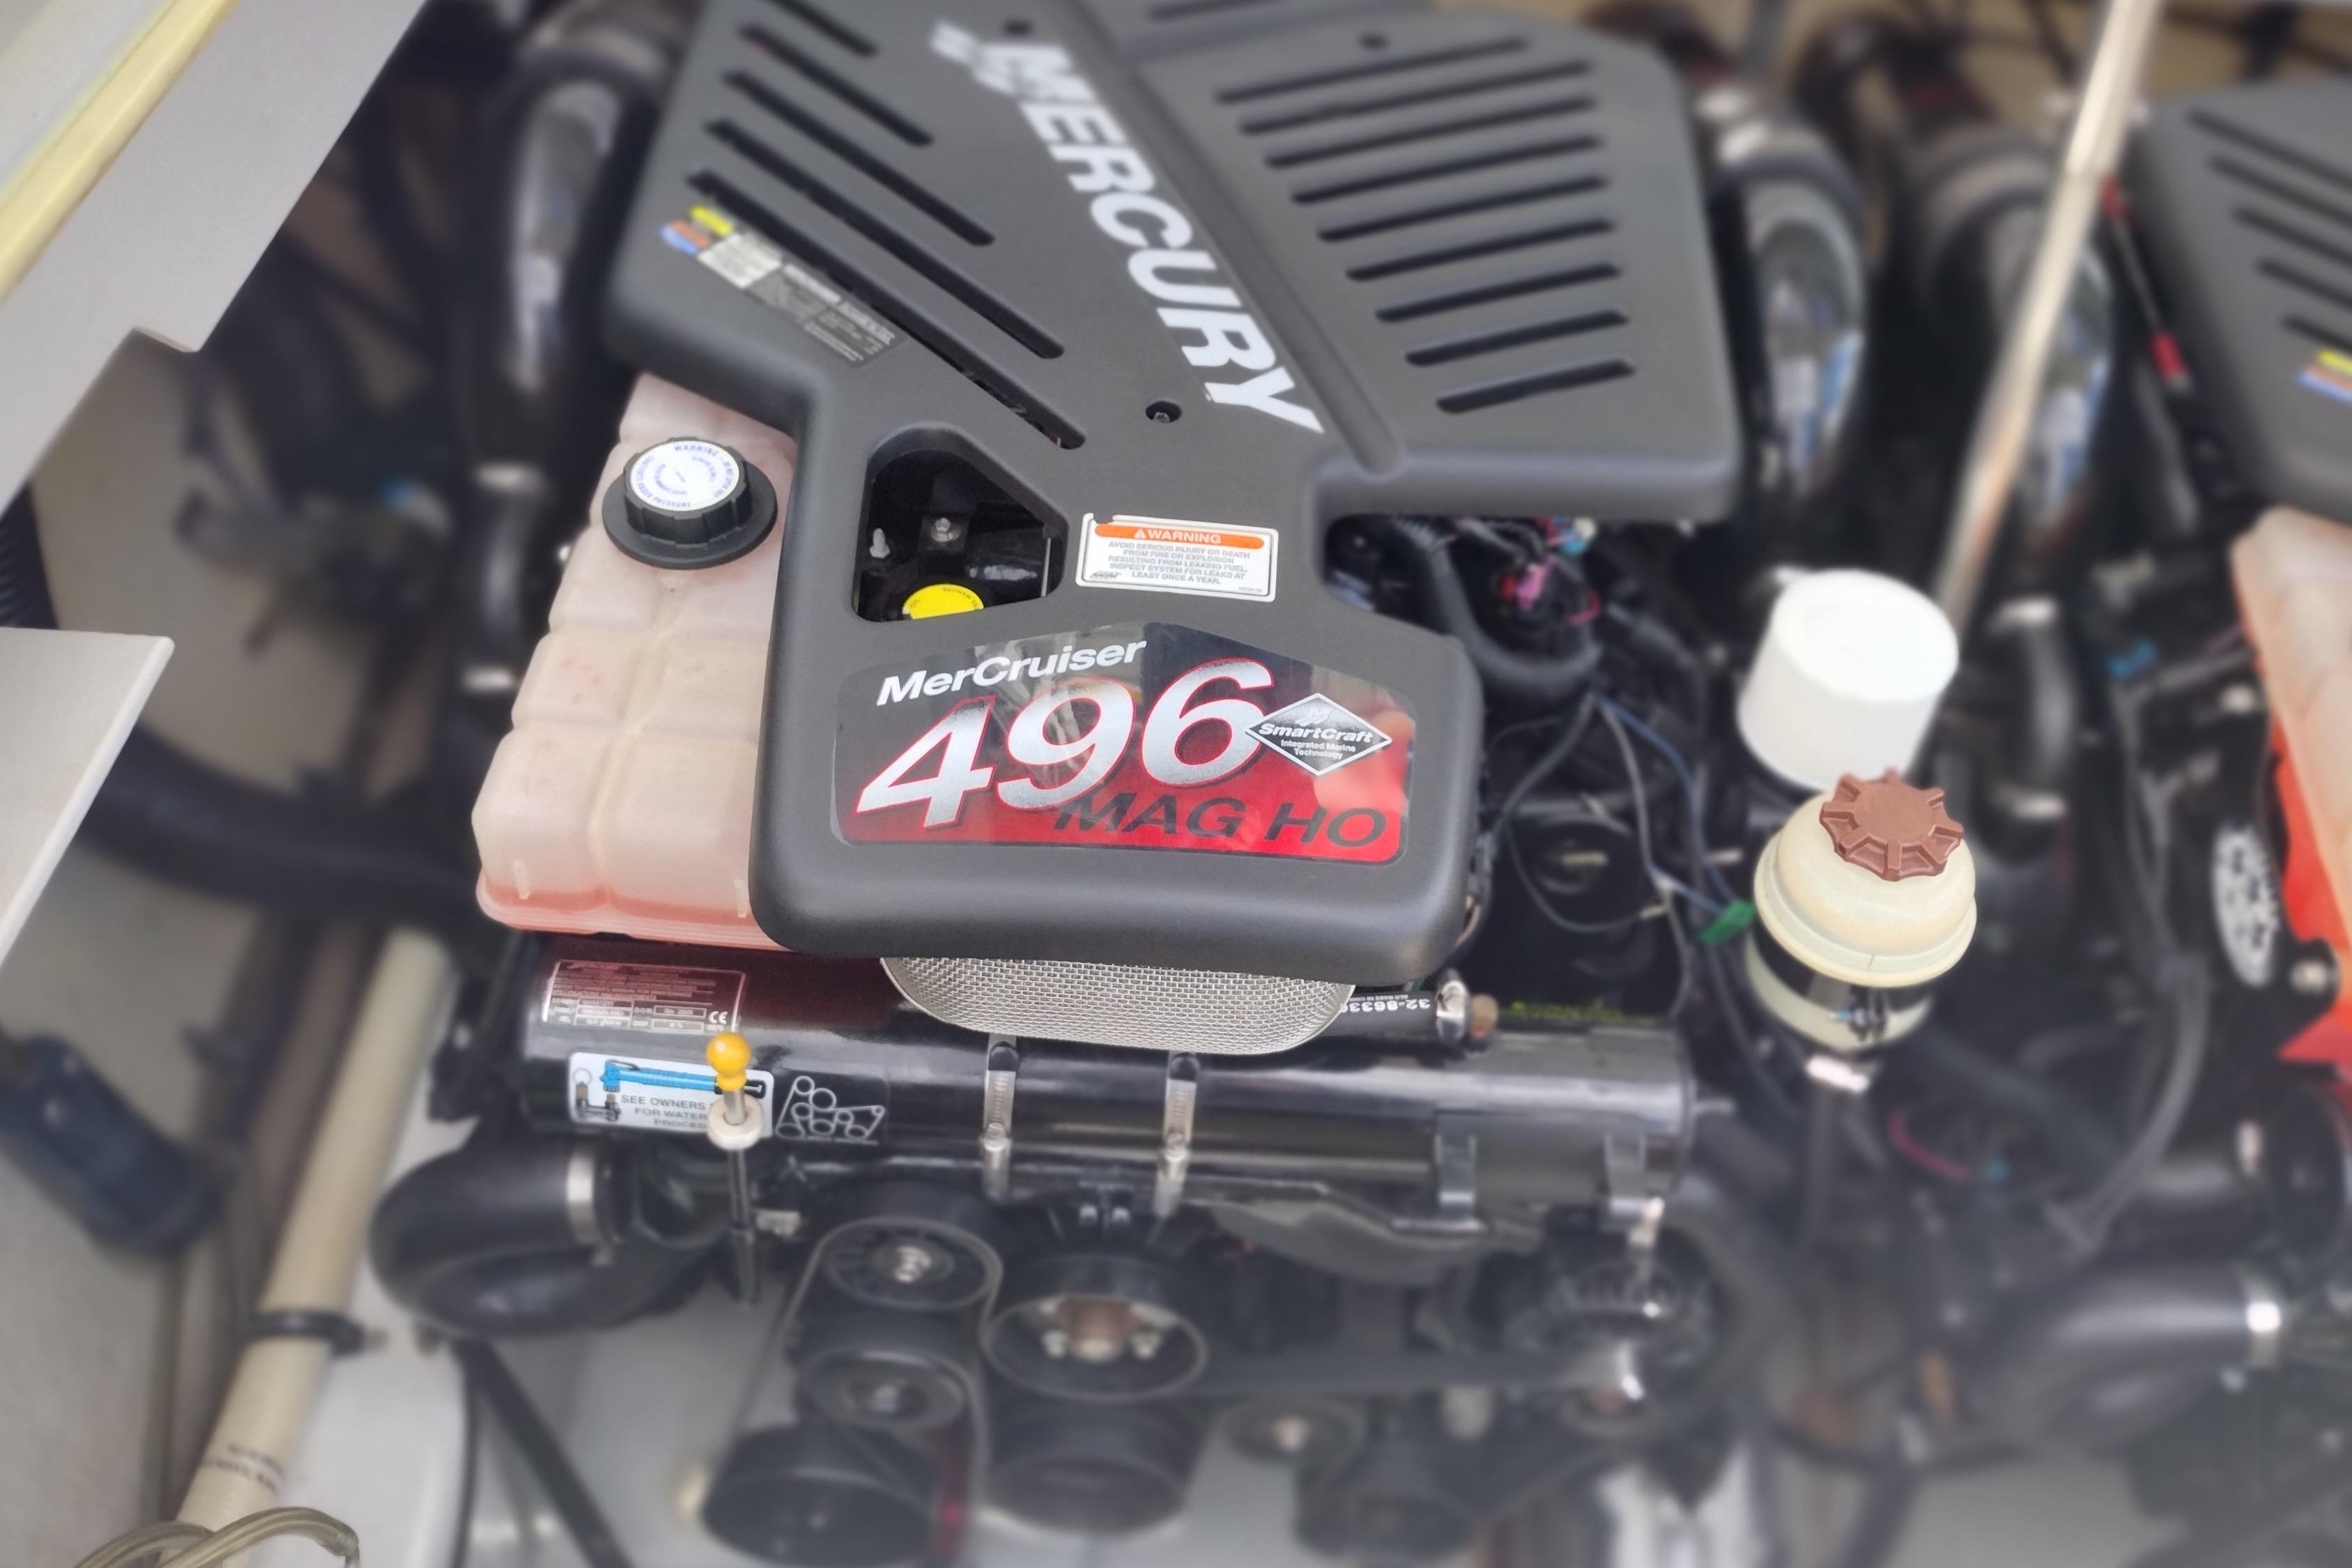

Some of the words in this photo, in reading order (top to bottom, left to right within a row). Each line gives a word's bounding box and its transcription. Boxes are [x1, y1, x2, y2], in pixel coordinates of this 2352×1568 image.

[973, 43, 1324, 433] MERCURY
[674, 444, 720, 457] WARNING
[1147, 529, 1222, 544] WARNING
[1108, 541, 1135, 549] AVOID
[1137, 544, 1174, 552] SERIOUS
[1176, 546, 1206, 555] INJURY
[1222, 550, 1250, 559] DEATH
[1108, 555, 1156, 564] RESULTING
[1185, 561, 1222, 570] LEAKING
[1186, 553, 1234, 564] EXPLOSION
[1109, 562, 1146, 571] INSPECT
[1148, 565, 1183, 574] SYSTEM
[1204, 569, 1233, 579] LEAKS
[1161, 573, 1186, 581] ONCE
[1196, 576, 1221, 585] YEAR.
[875, 640, 1147, 706] MerCruiser
[1259, 723, 1374, 744] SmartCraft
[855, 658, 1274, 829] 496
[1281, 739, 1325, 750] Integrated
[1326, 742, 1356, 753] Marine
[1294, 748, 1344, 760] Technology
[1052, 792, 1244, 839] MAG
[1265, 803, 1388, 848] HO
[621, 1094, 646, 1105] SEE
[650, 1097, 706, 1111] OWNERS
[635, 1107, 660, 1116] FOR
[663, 1109, 707, 1121] WATER
[654, 1119, 707, 1128] PROCED
